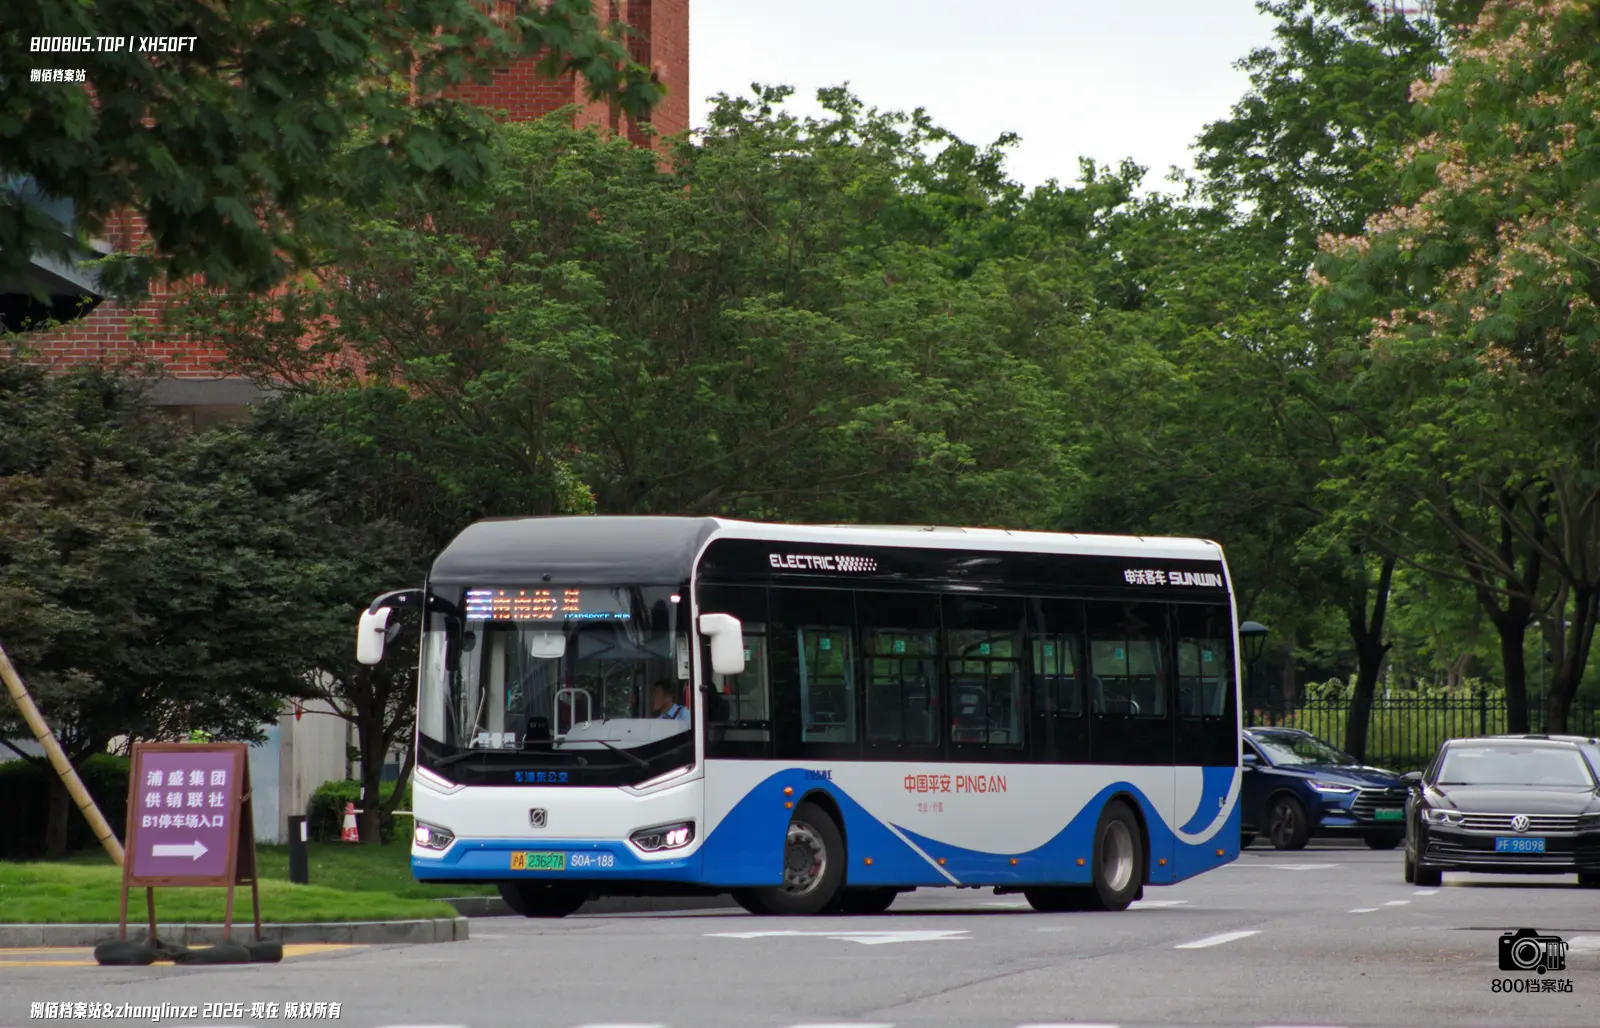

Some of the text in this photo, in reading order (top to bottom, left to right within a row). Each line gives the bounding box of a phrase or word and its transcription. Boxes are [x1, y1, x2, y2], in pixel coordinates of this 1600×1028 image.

[769, 553, 836, 570] ELECTRIC
[1123, 568, 1223, 588] 申沃客车 SUNWIN
[146, 770, 226, 787] 浦盛集团
[904, 774, 1007, 793] 中国平安 PINGAN
[144, 792, 224, 808] 供销联社
[142, 814, 224, 828] B1停车场入口
[1513, 839, 1544, 851] 98098
